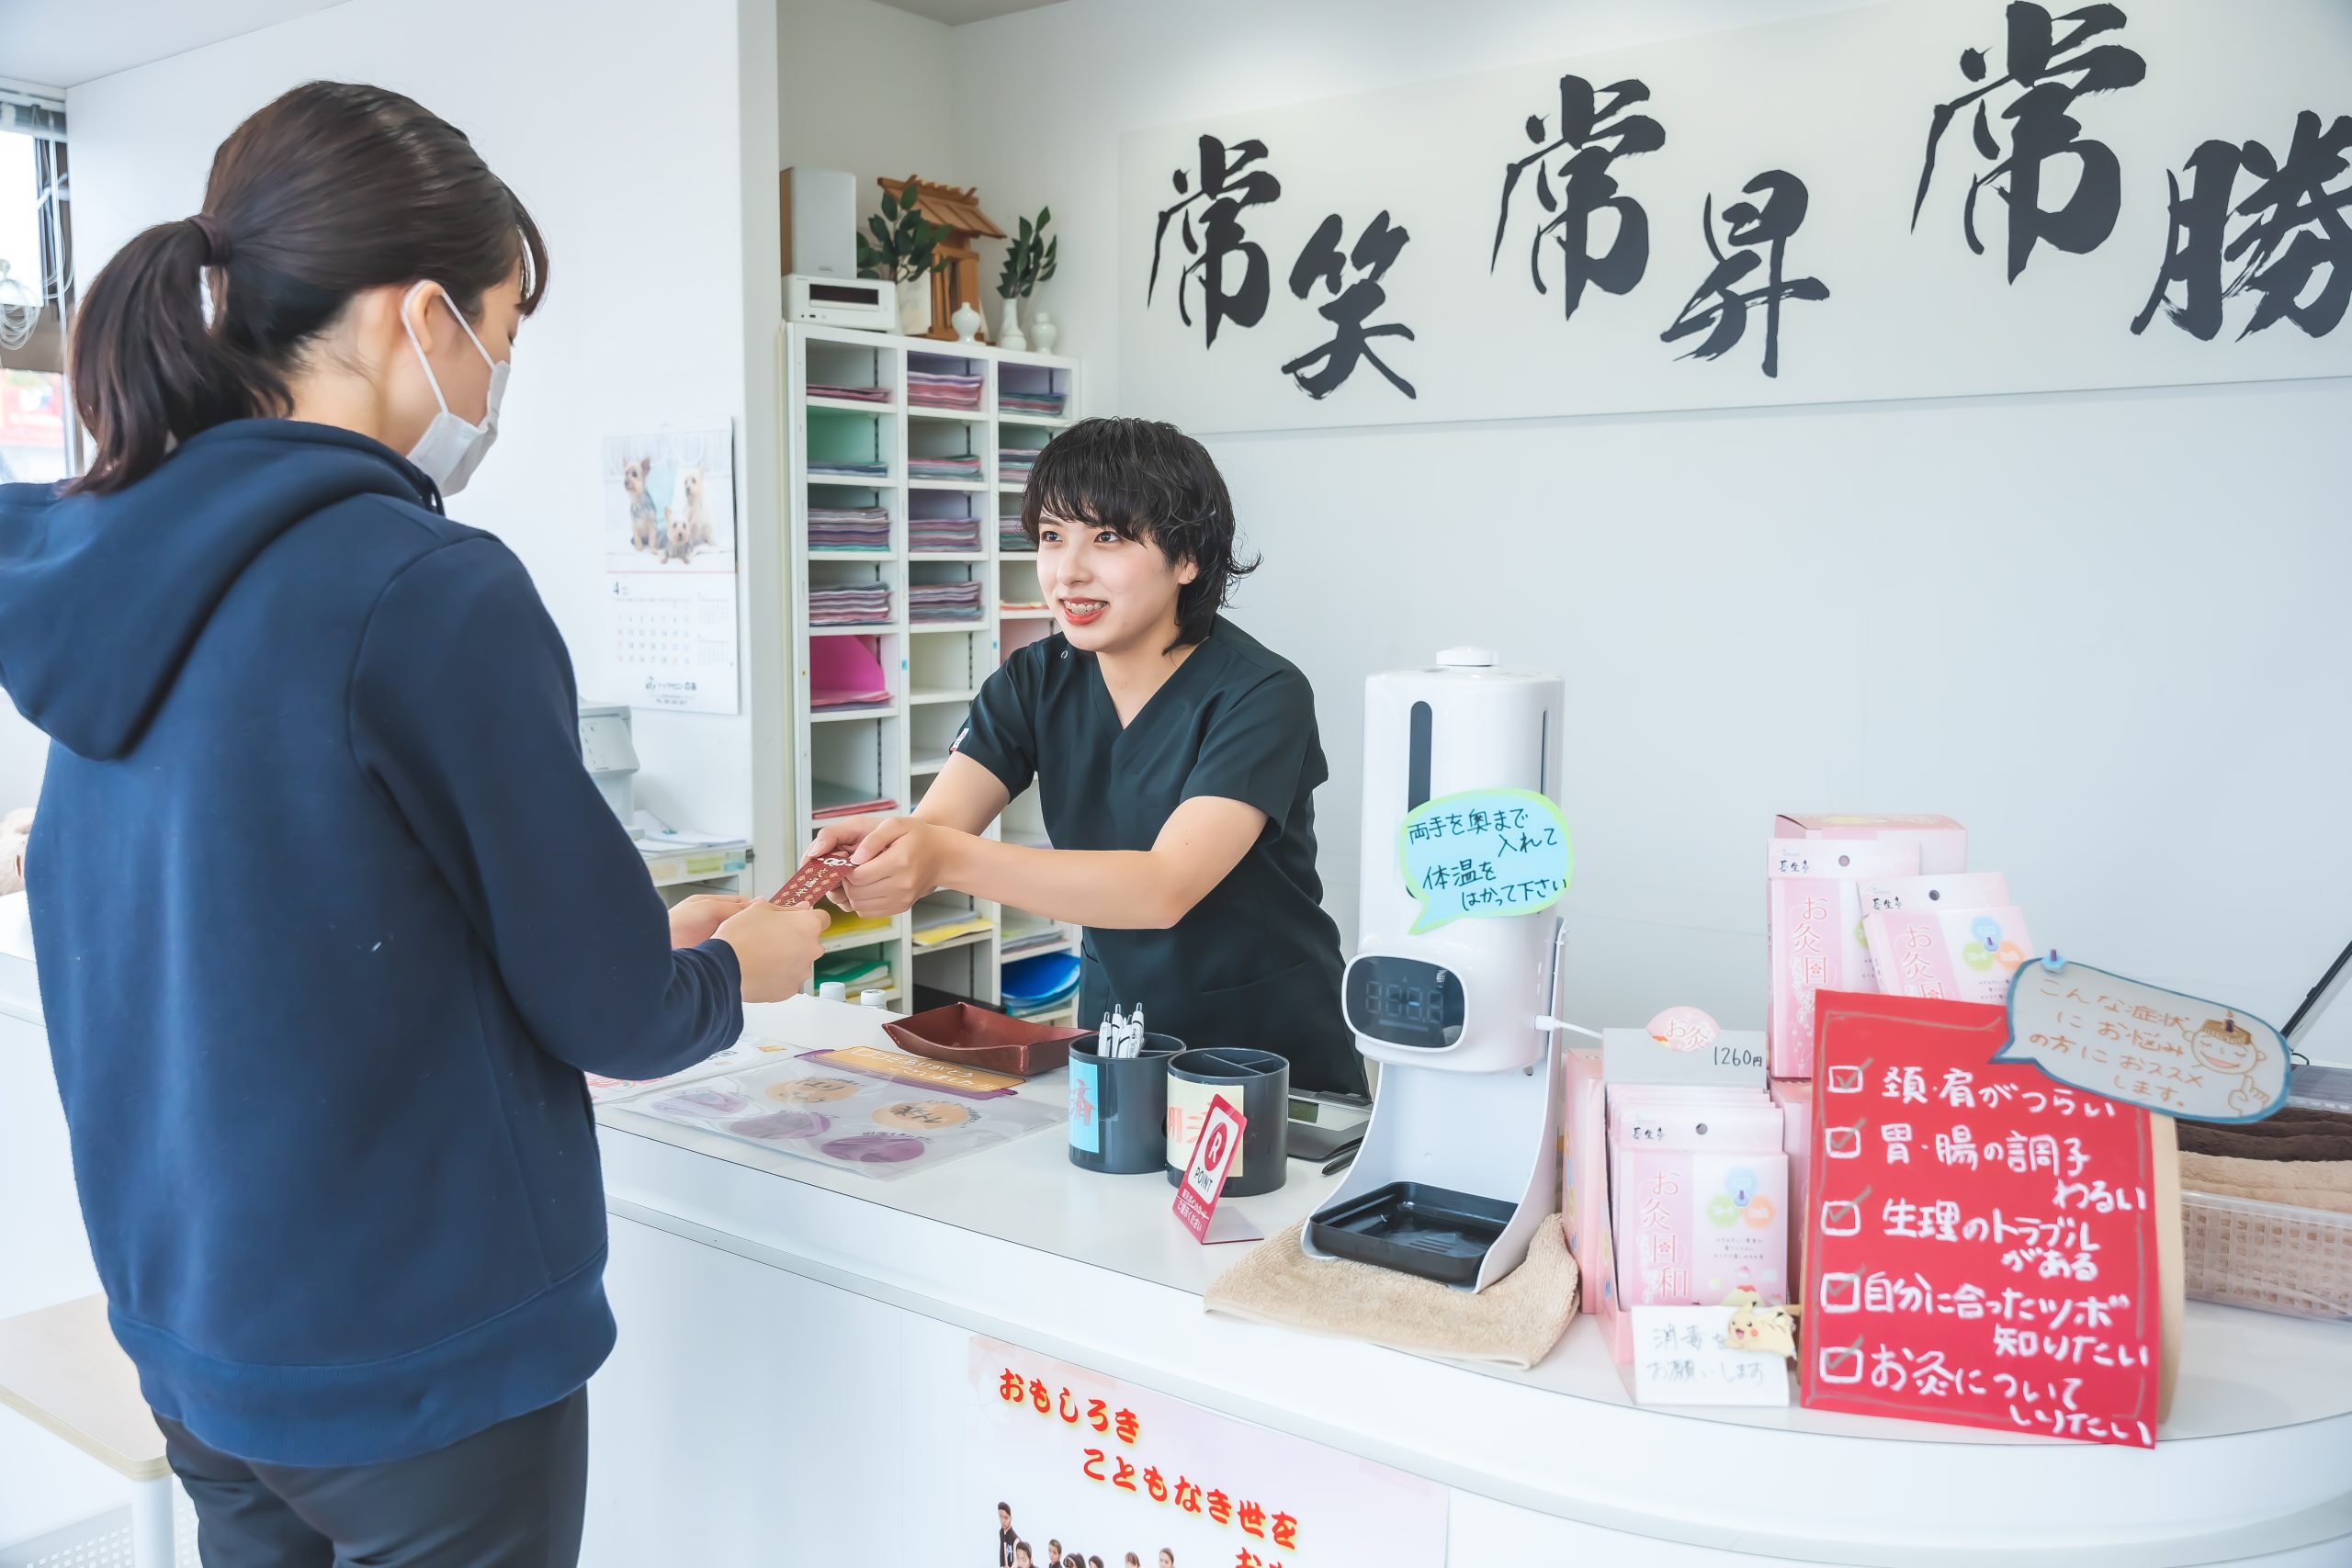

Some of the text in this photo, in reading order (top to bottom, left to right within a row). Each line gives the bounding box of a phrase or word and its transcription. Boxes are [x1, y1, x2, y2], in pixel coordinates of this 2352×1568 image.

[1408, 808, 1529, 845] 両手を奥まで
[1498, 828, 1558, 858] 入れて
[1422, 859, 1497, 890] 体温を
[1462, 878, 1567, 911] はかって下さい
[2040, 978, 2190, 1032] こんな症状
[1667, 1019, 1708, 1050] お灸
[1713, 1046, 1763, 1067] 1260円
[1193, 1167, 1214, 1193] POINT
[2052, 1180, 2146, 1213] わるい
[1882, 1198, 2100, 1251] 生理のトラブル
[2001, 1249, 2099, 1280] がある
[1864, 1271, 2131, 1329] 自分に合ったツボ
[1993, 1323, 2149, 1367] 知りたい
[1646, 1359, 1764, 1387] お願いします
[1870, 1344, 2083, 1411] お灸について
[999, 1368, 1139, 1444] おもしろき
[1082, 1448, 1298, 1551] こともなき世を
[1235, 1546, 1283, 1568] お
